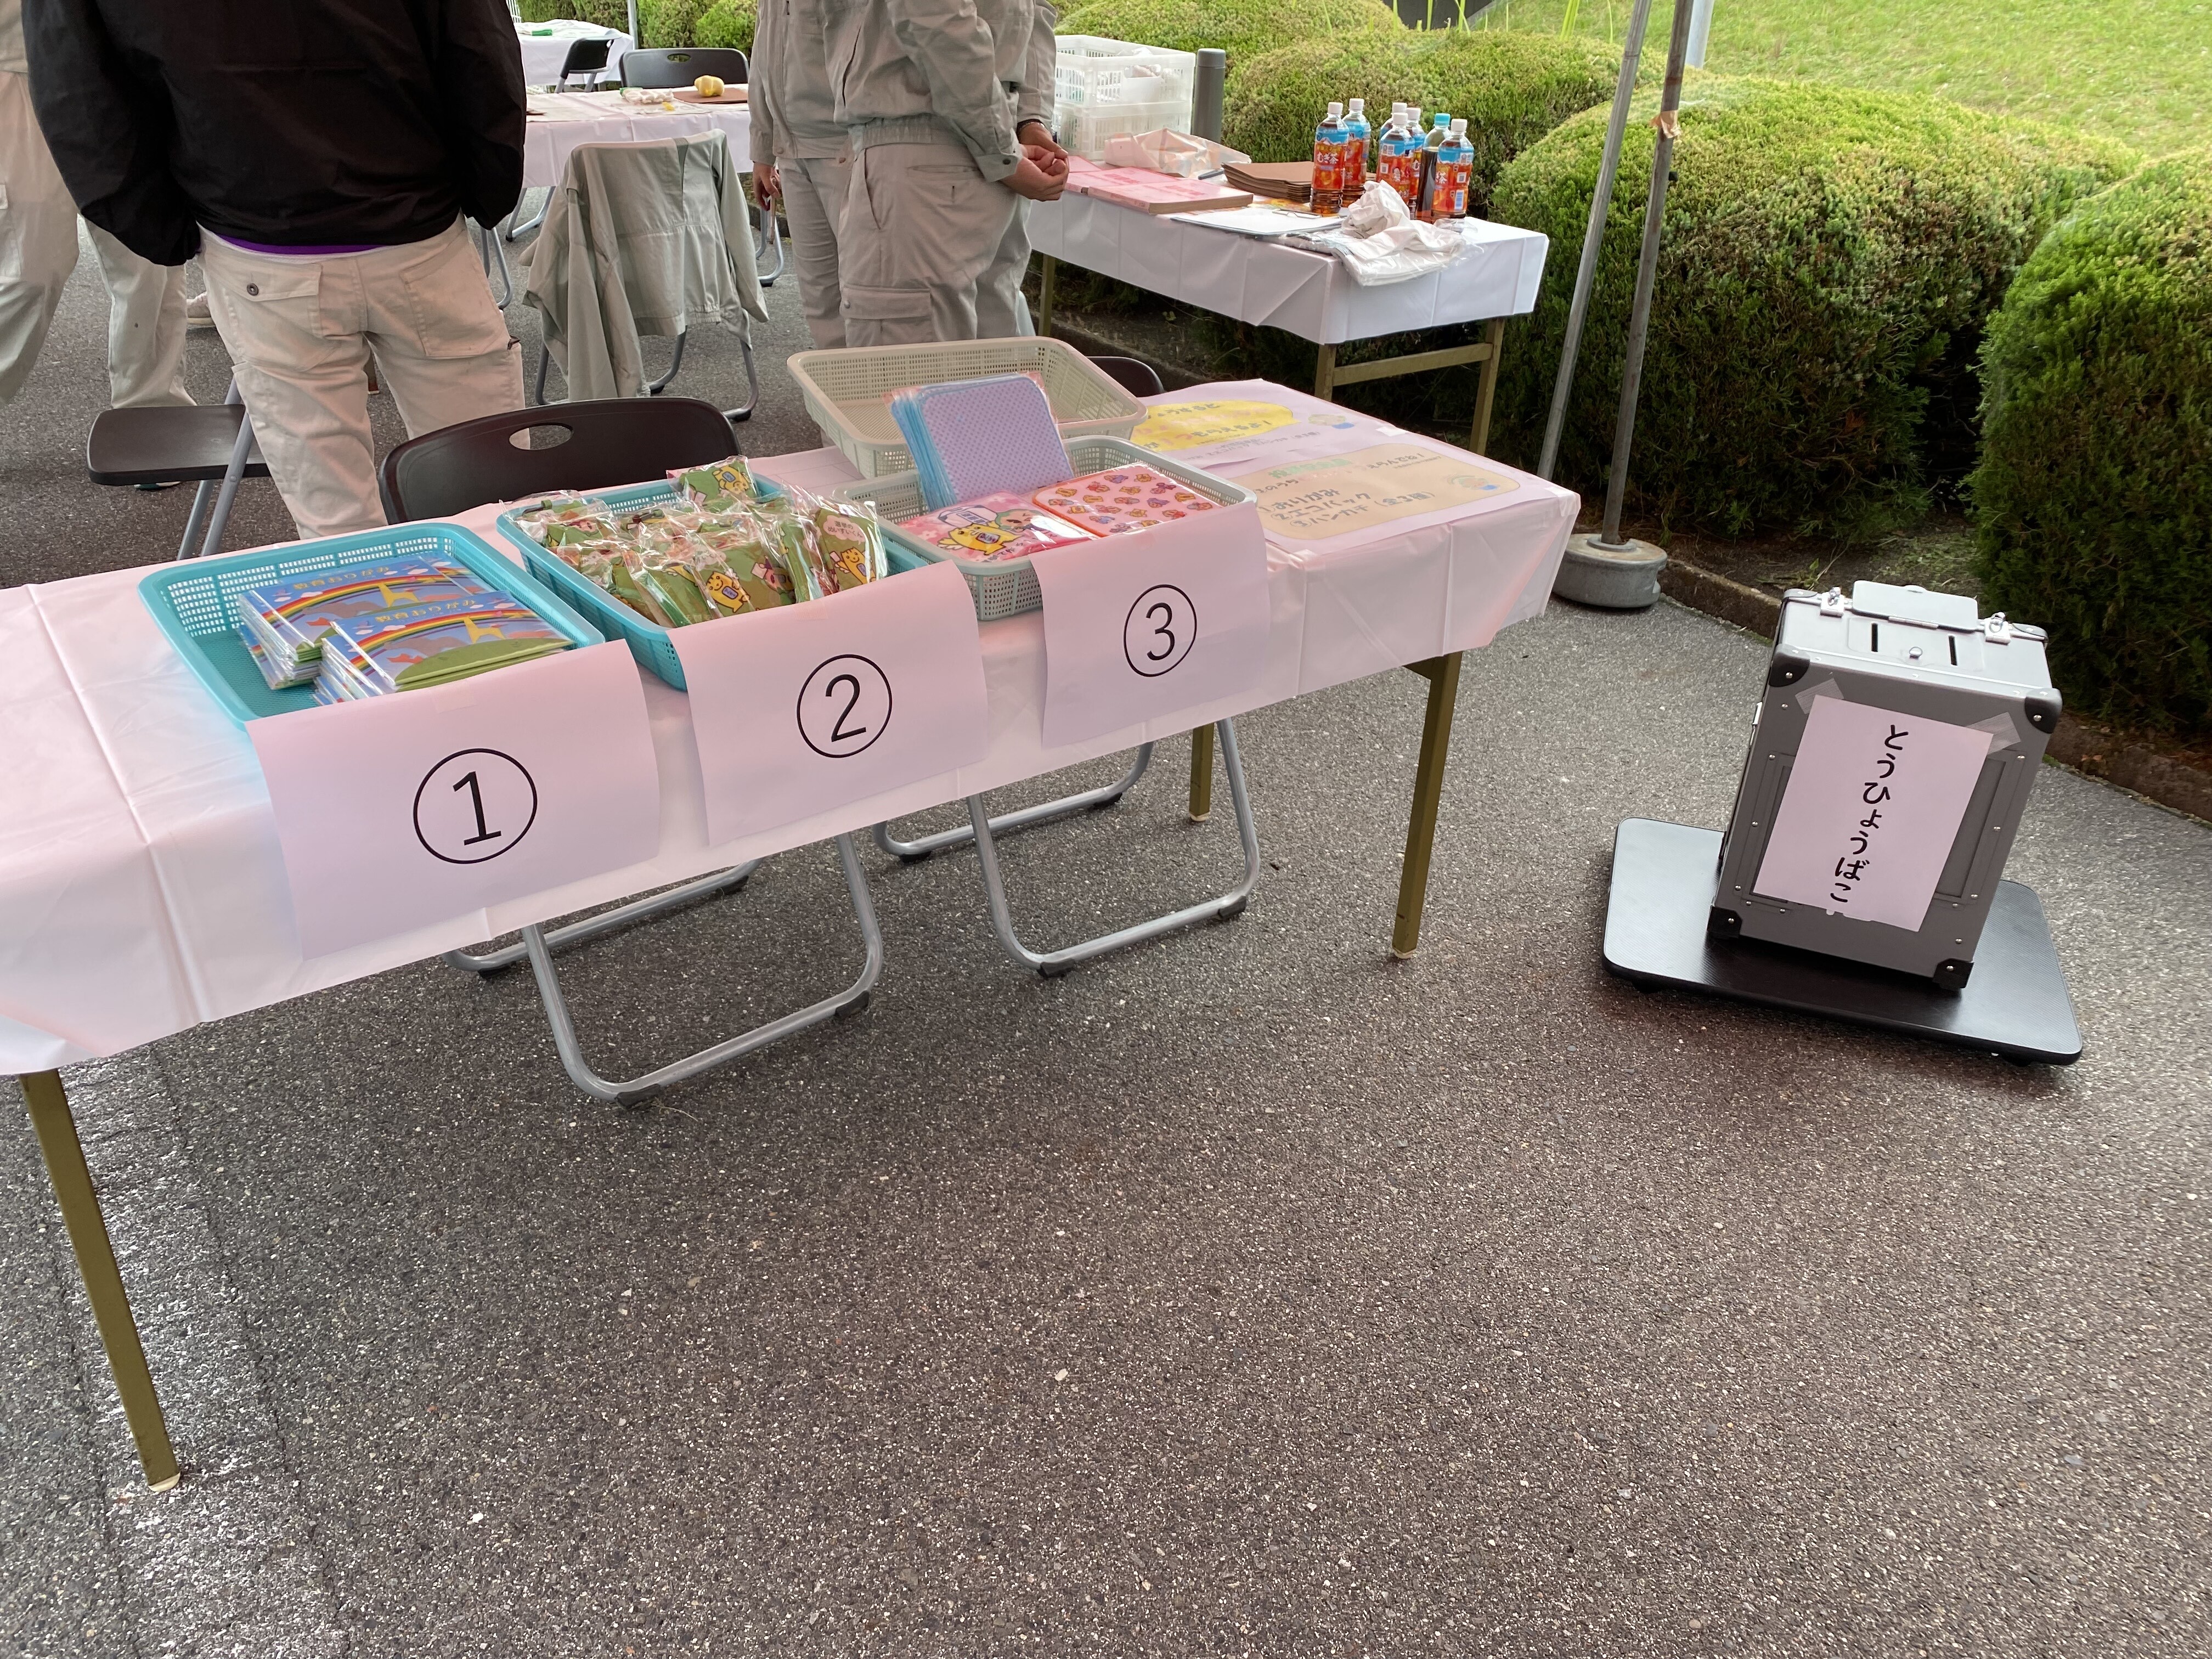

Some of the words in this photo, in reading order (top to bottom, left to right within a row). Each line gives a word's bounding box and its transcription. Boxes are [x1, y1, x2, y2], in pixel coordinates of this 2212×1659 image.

[1317, 151, 1339, 164] むぎ茶
[375, 600, 476, 623] 教育おりがみ
[1123, 584, 1198, 678] ③
[797, 654, 893, 758] ②
[413, 748, 538, 864] ①
[1830, 724, 1909, 903] とうひょうばこ
